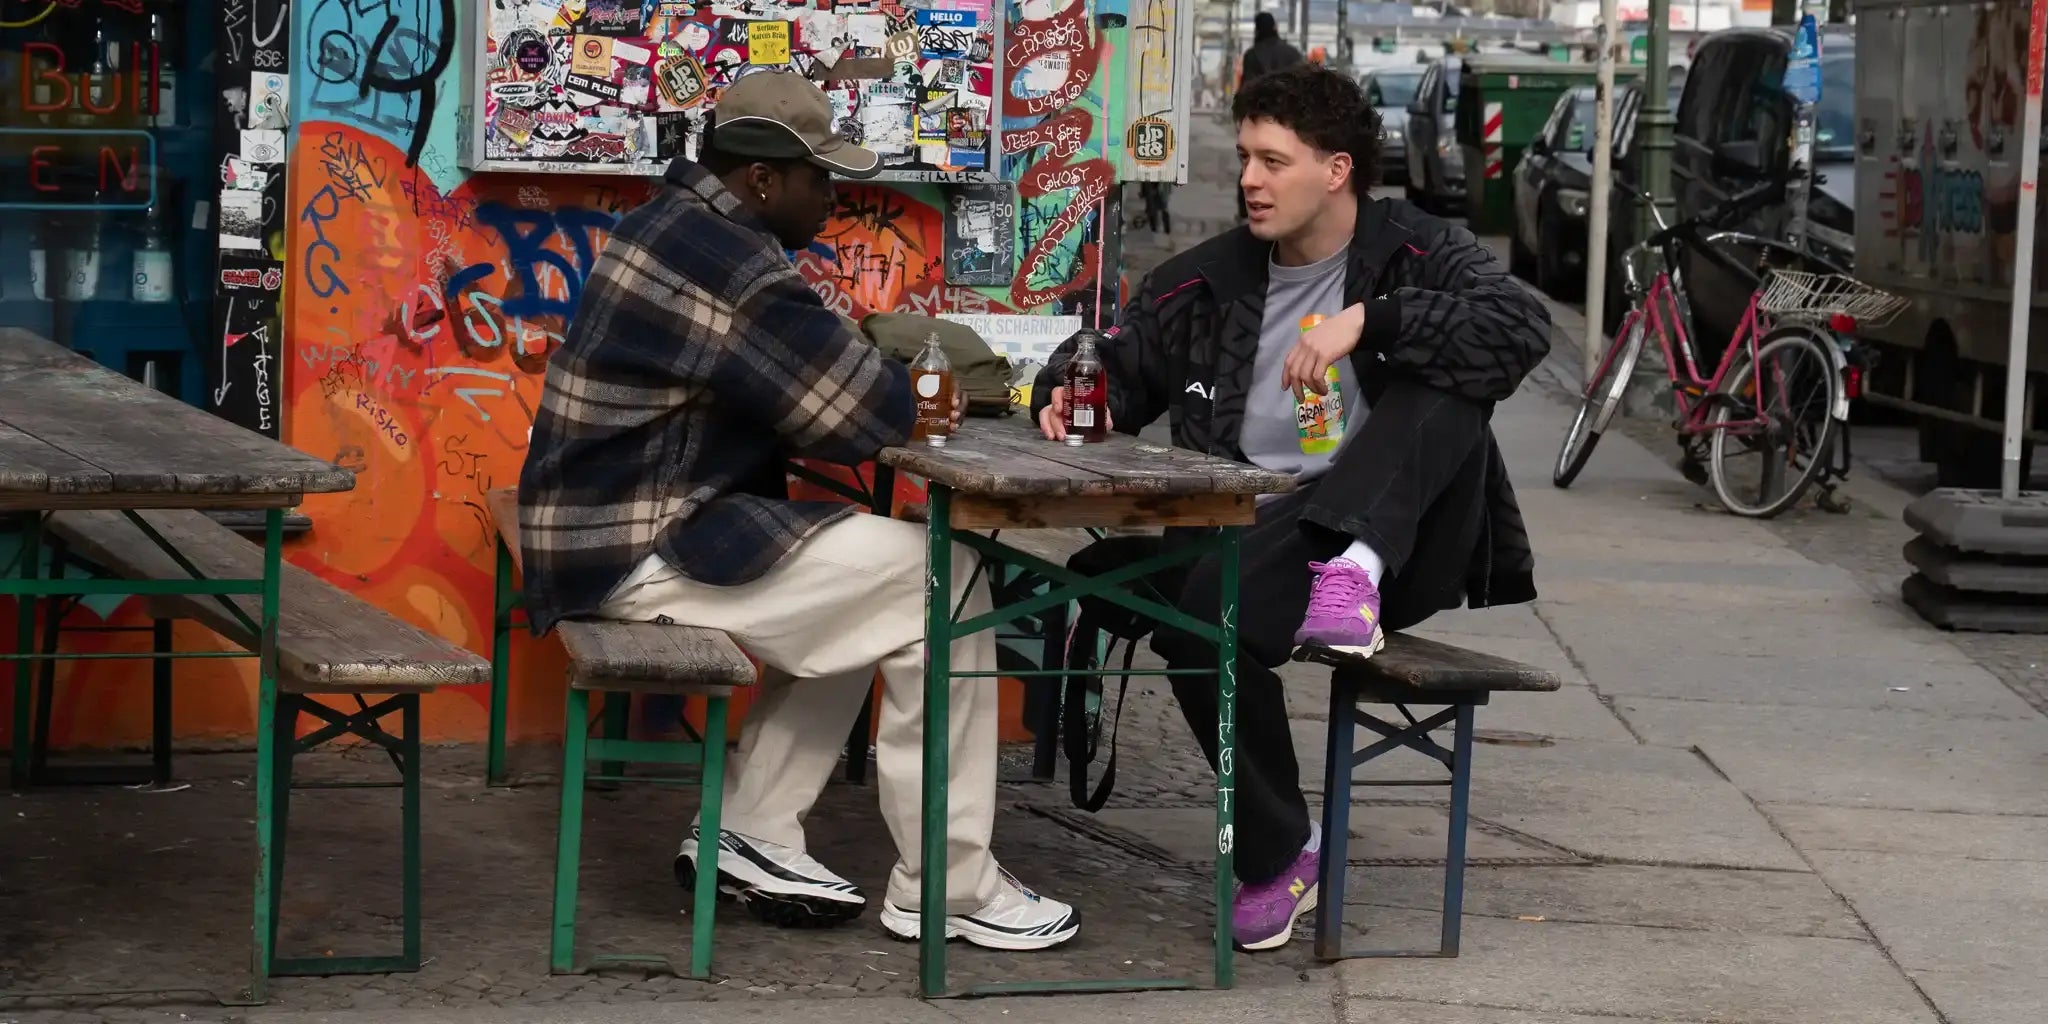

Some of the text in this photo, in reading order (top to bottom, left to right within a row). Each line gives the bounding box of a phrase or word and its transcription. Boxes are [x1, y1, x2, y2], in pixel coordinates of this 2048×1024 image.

[930, 12, 963, 22] HELLO
[22, 41, 160, 116] Bull
[591, 82, 618, 97] PLEM
[1001, 131, 1040, 154] NEED
[1288, 878, 1305, 898] N
